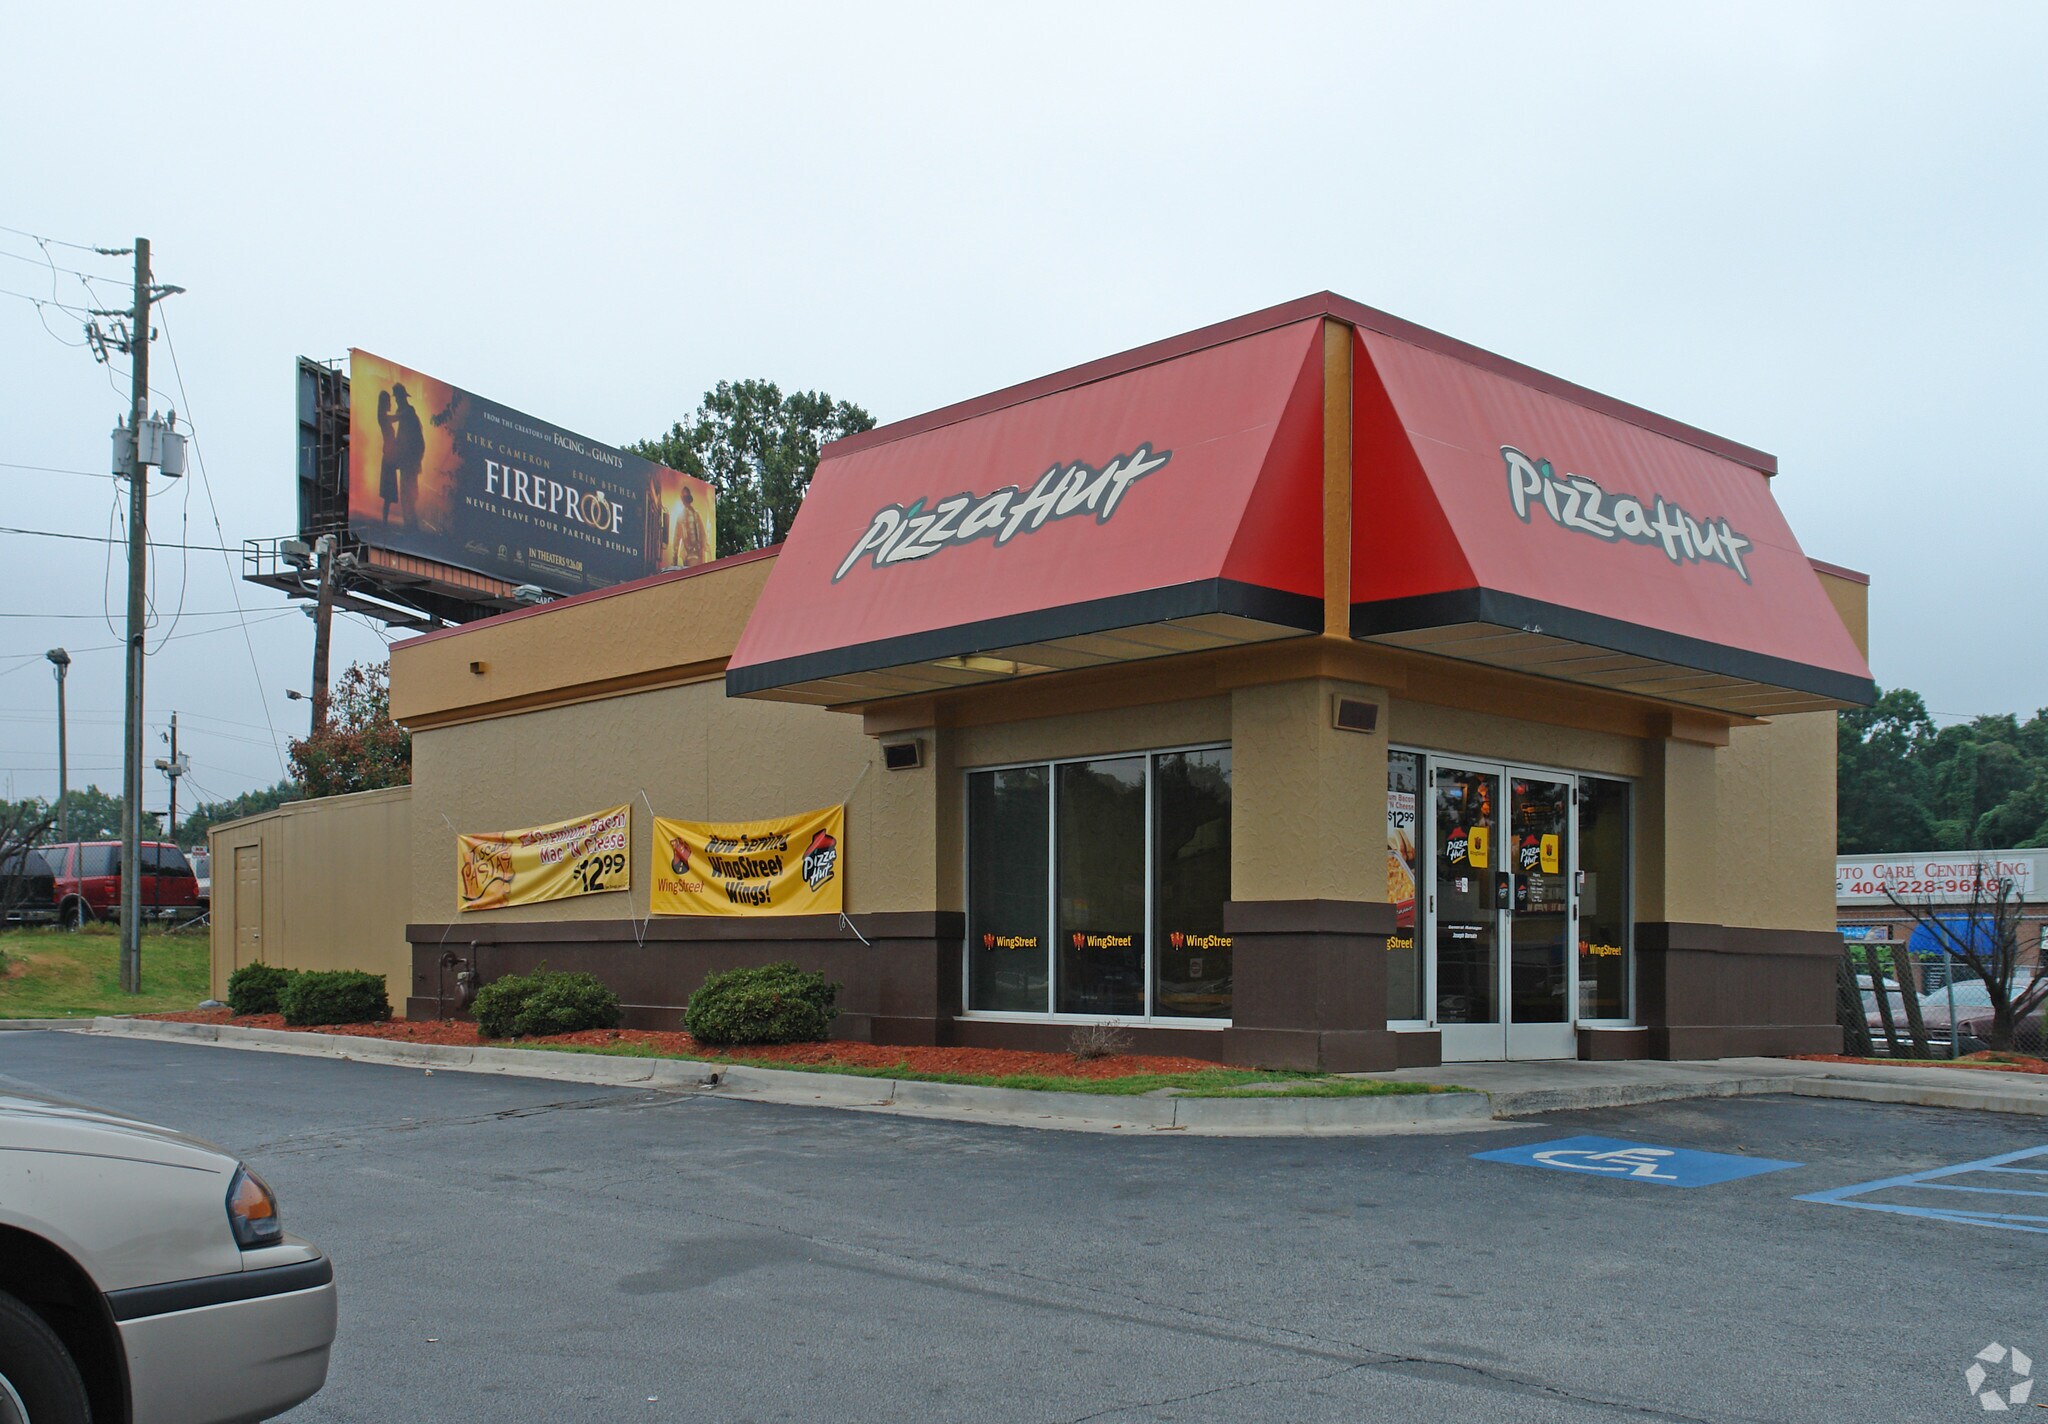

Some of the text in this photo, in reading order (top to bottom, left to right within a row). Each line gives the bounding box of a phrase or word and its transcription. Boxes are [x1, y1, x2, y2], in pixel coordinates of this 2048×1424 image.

[466, 432, 550, 469] KIRK CAMERON
[483, 411, 500, 424] FROM
[502, 418, 513, 429] THE
[514, 423, 543, 439] CREATORS
[544, 434, 551, 442] OF
[553, 432, 585, 455] FACING
[591, 447, 623, 469] GIANTS
[572, 469, 637, 500] ERIN BETHEA
[484, 458, 624, 534] FIREPROOF
[465, 496, 638, 557] NEVER LEAVE YOUR PARTNER BEHIND
[528, 547, 537, 559] IN
[537, 549, 566, 567] THEATERS
[534, 824, 588, 846] Premium
[589, 812, 626, 835] Bacon
[539, 847, 564, 865] Mac
[584, 833, 626, 855] Cheese
[704, 832, 792, 854] Now Serving
[1446, 840, 1469, 857] Pizza
[802, 849, 837, 880] Pizza
[1450, 849, 1466, 861] Hut
[1520, 847, 1541, 863] Pizza
[1524, 855, 1539, 867] Hut
[708, 854, 784, 881] WingStreet
[810, 862, 833, 888] Hut
[1836, 867, 1864, 880] UTO
[1872, 864, 1916, 879] CARE
[1924, 862, 1989, 878] CENTER
[657, 878, 705, 896] WingStreet
[725, 880, 772, 906] Wings!
[996, 935, 1038, 949] WingStreet
[1086, 935, 1132, 949] WingStreet
[1386, 936, 1414, 951] gStreet
[1589, 943, 1623, 957] WingStreet
